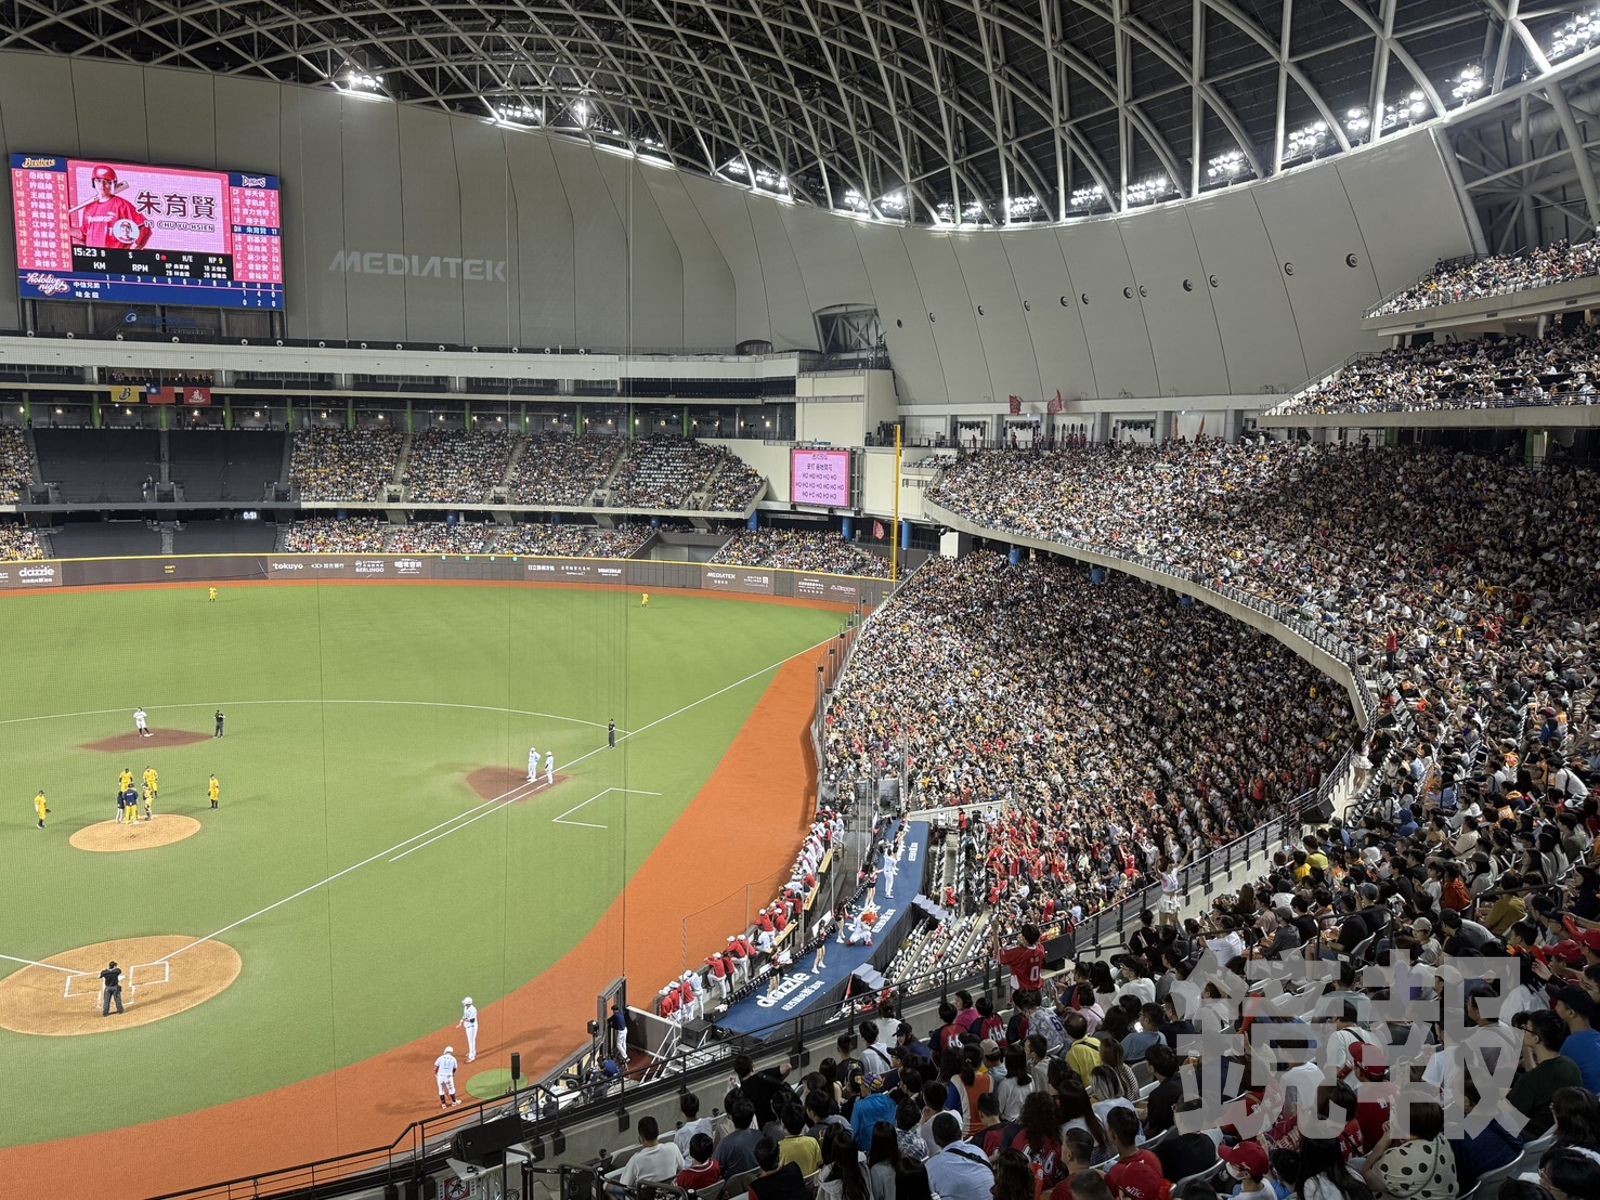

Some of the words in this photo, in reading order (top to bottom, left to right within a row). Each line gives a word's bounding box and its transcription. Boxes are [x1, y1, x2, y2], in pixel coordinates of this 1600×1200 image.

[22, 158, 55, 168] Brothers
[137, 192, 215, 220] 朱育賢
[74, 247, 96, 257] 15:23
[94, 262, 106, 270] KM
[132, 264, 148, 272] RPM
[330, 250, 506, 282] MEDIATEK
[19, 566, 54, 577] dazzle
[756, 972, 810, 1007] dazzle
